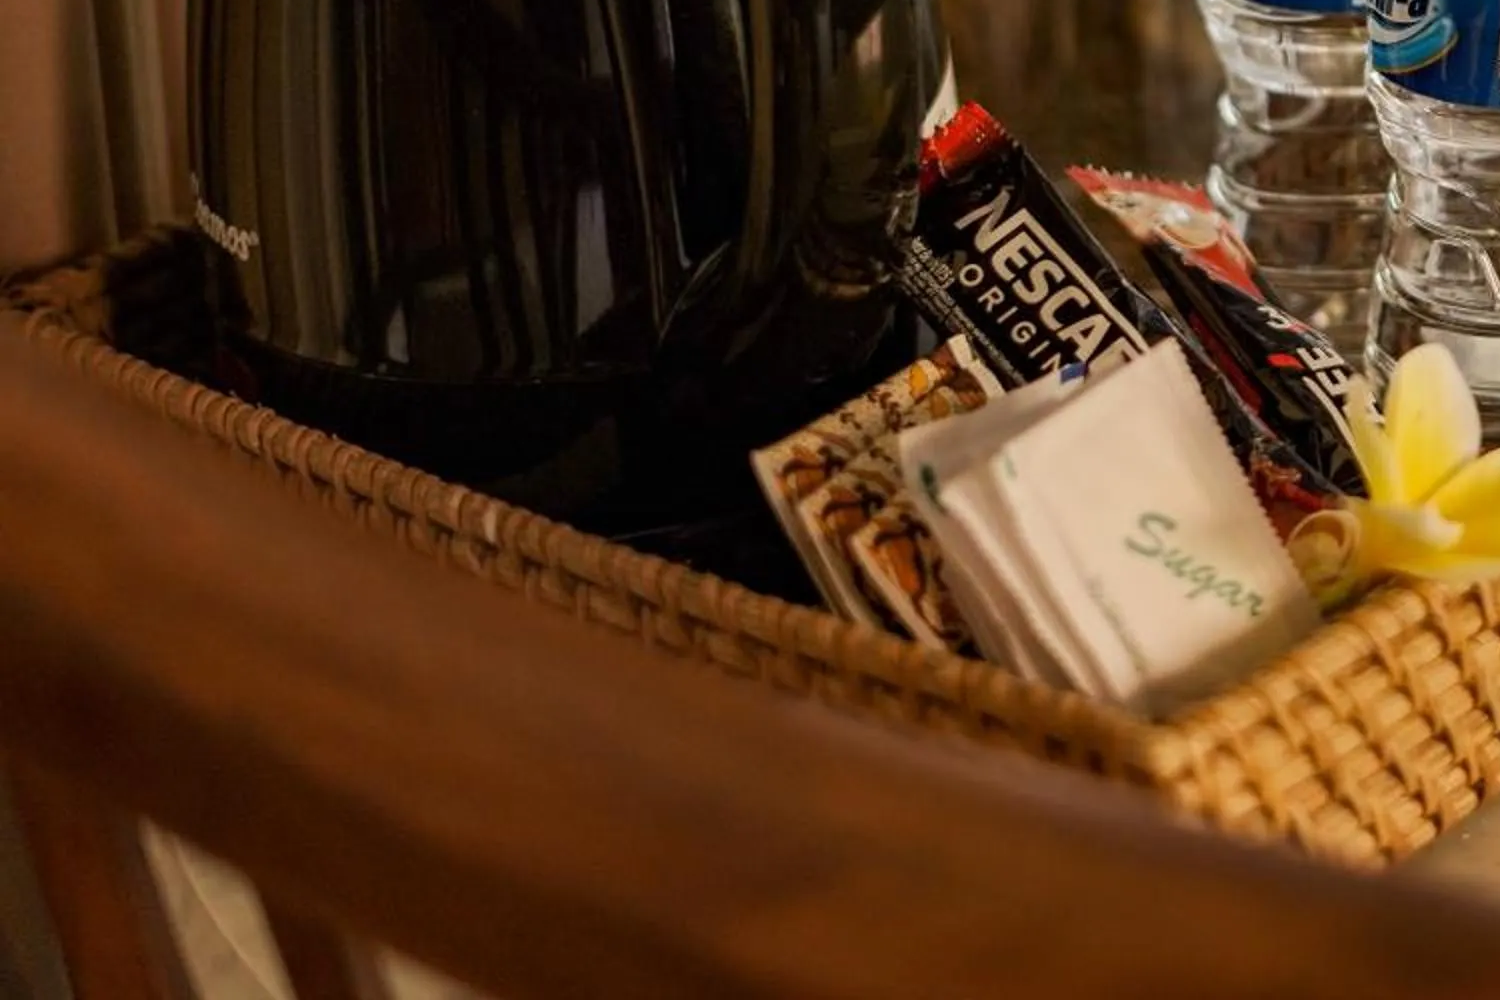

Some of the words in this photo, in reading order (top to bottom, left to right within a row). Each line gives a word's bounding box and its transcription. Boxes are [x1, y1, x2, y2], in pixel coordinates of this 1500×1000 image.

[953, 186, 1150, 383] NESCAF
[959, 263, 1062, 372] ORIGIN
[1124, 512, 1264, 617] Sugar
